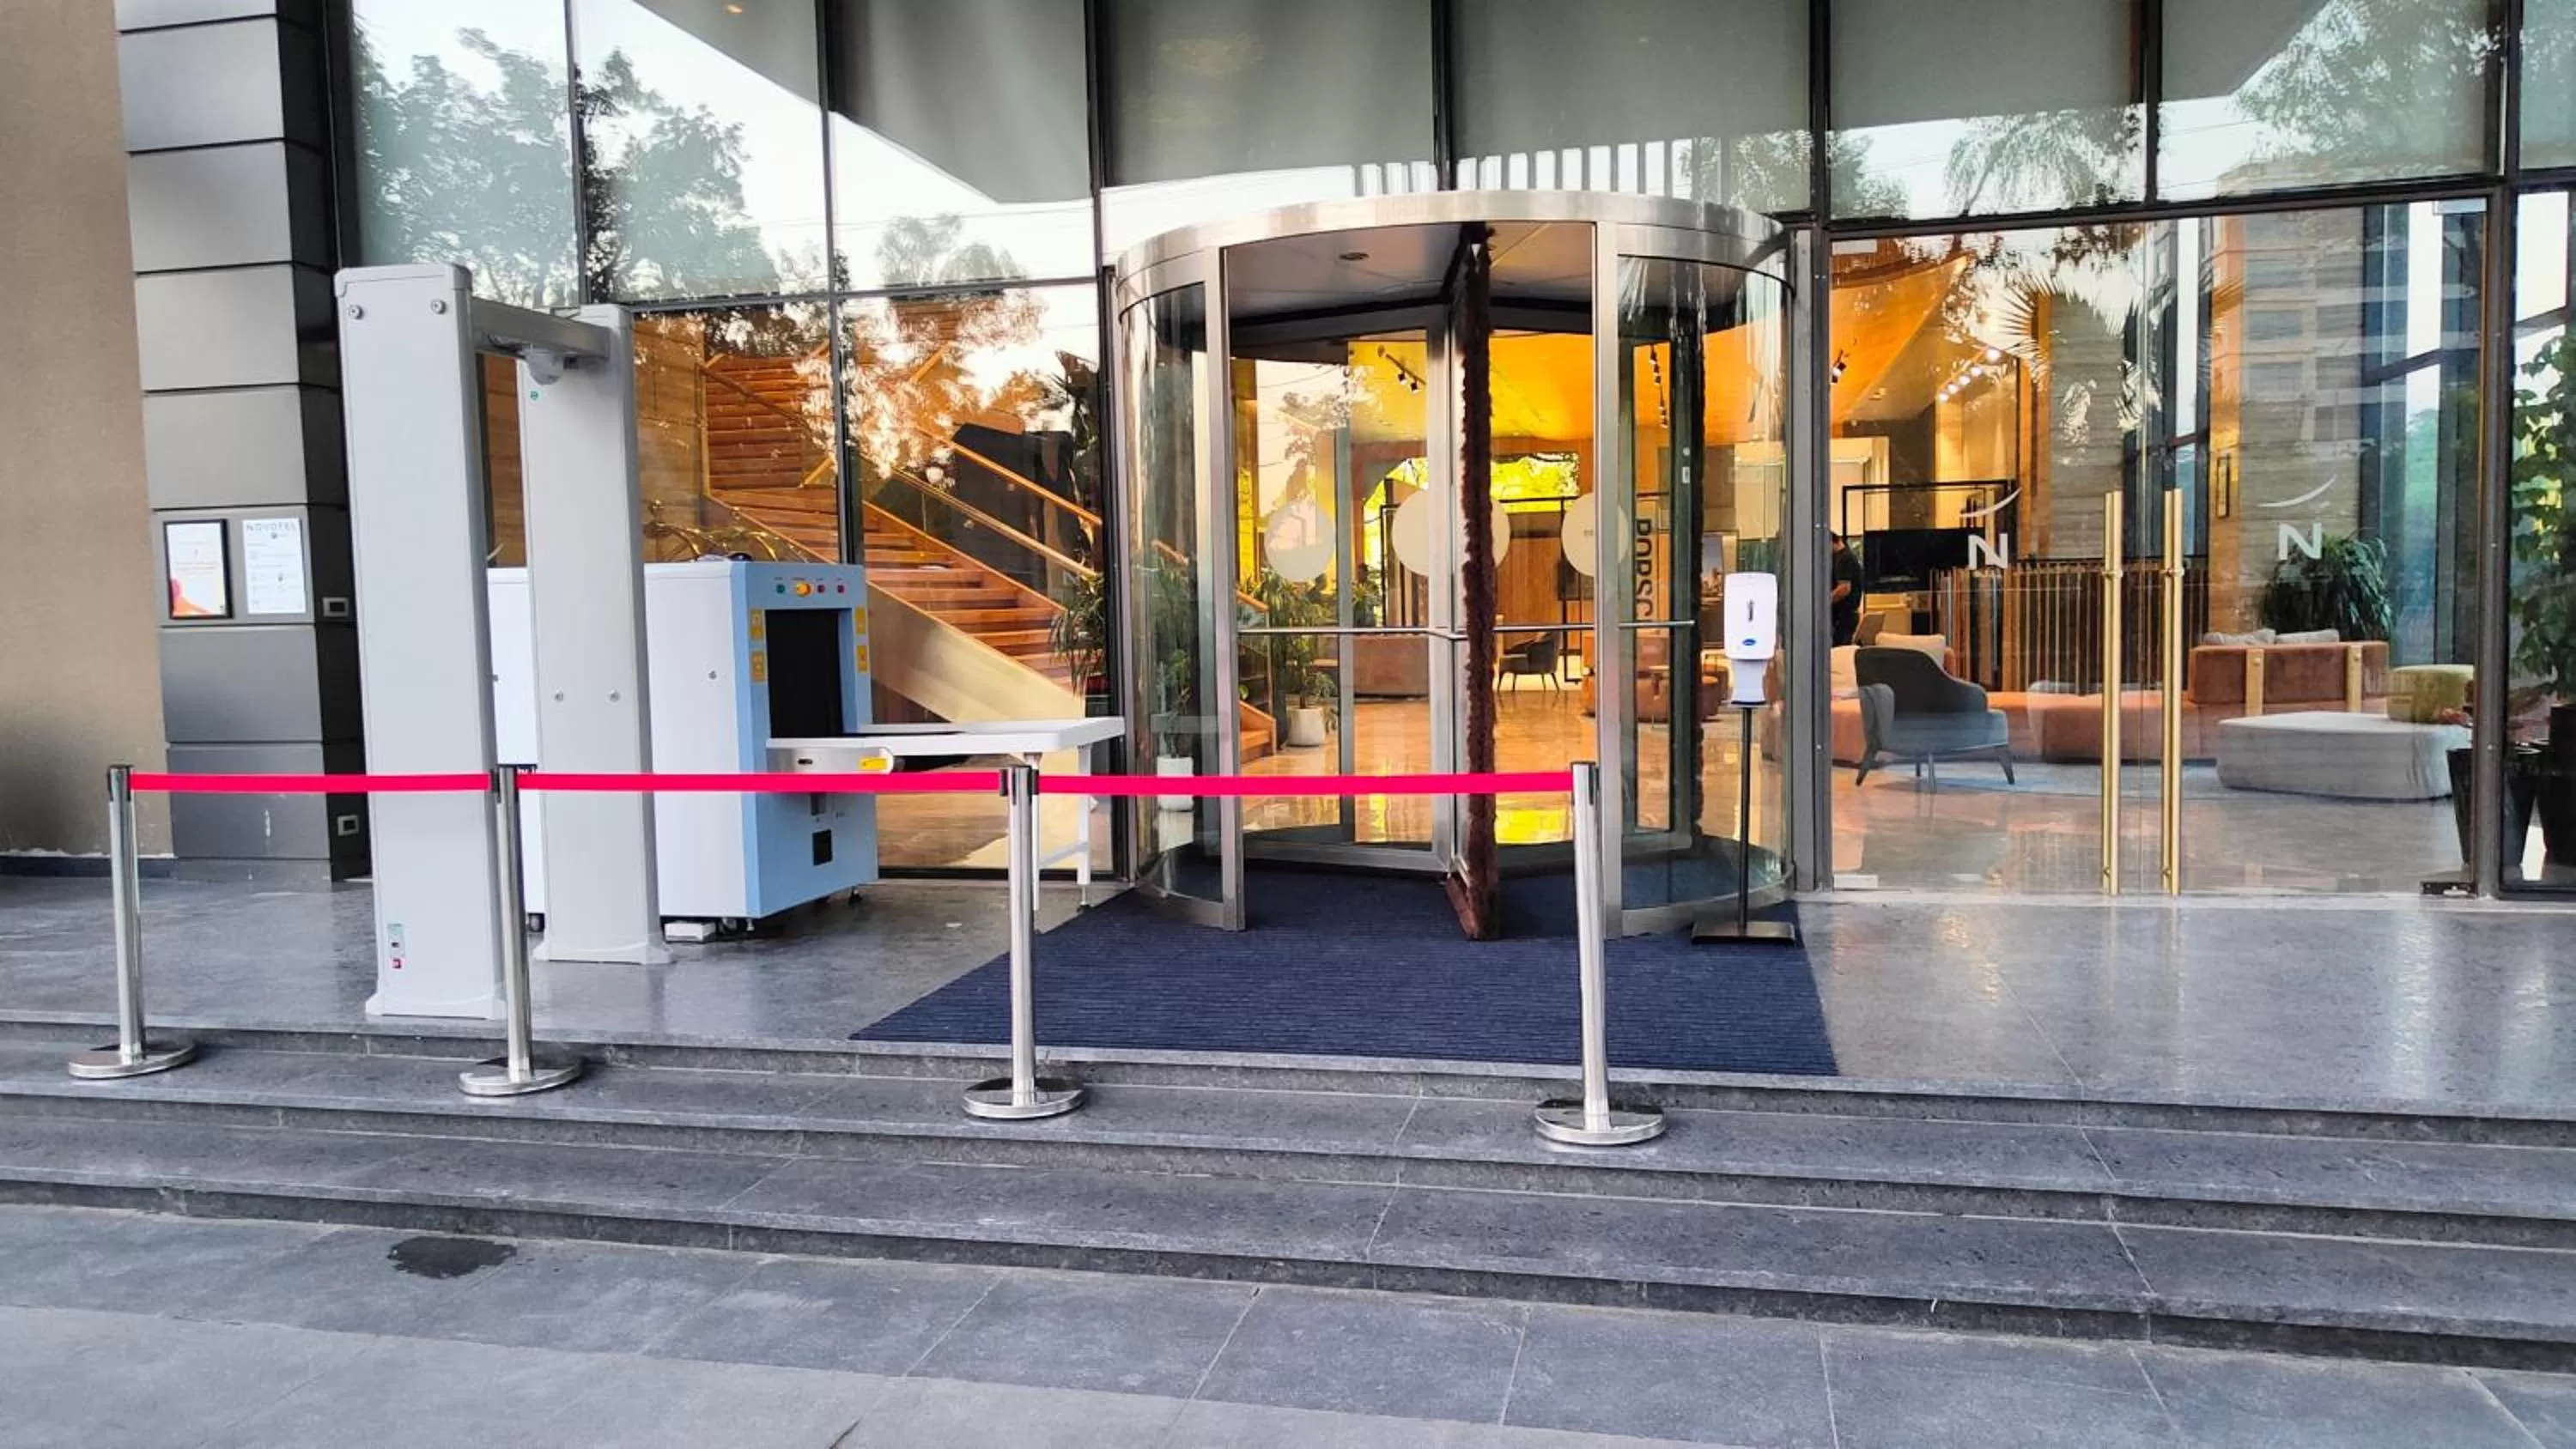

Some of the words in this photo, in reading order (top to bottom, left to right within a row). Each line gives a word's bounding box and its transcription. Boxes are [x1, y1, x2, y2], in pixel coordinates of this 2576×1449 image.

[1968, 533, 2008, 570] N
[2279, 523, 2322, 561] N
[1636, 518, 1653, 622] PORSC
